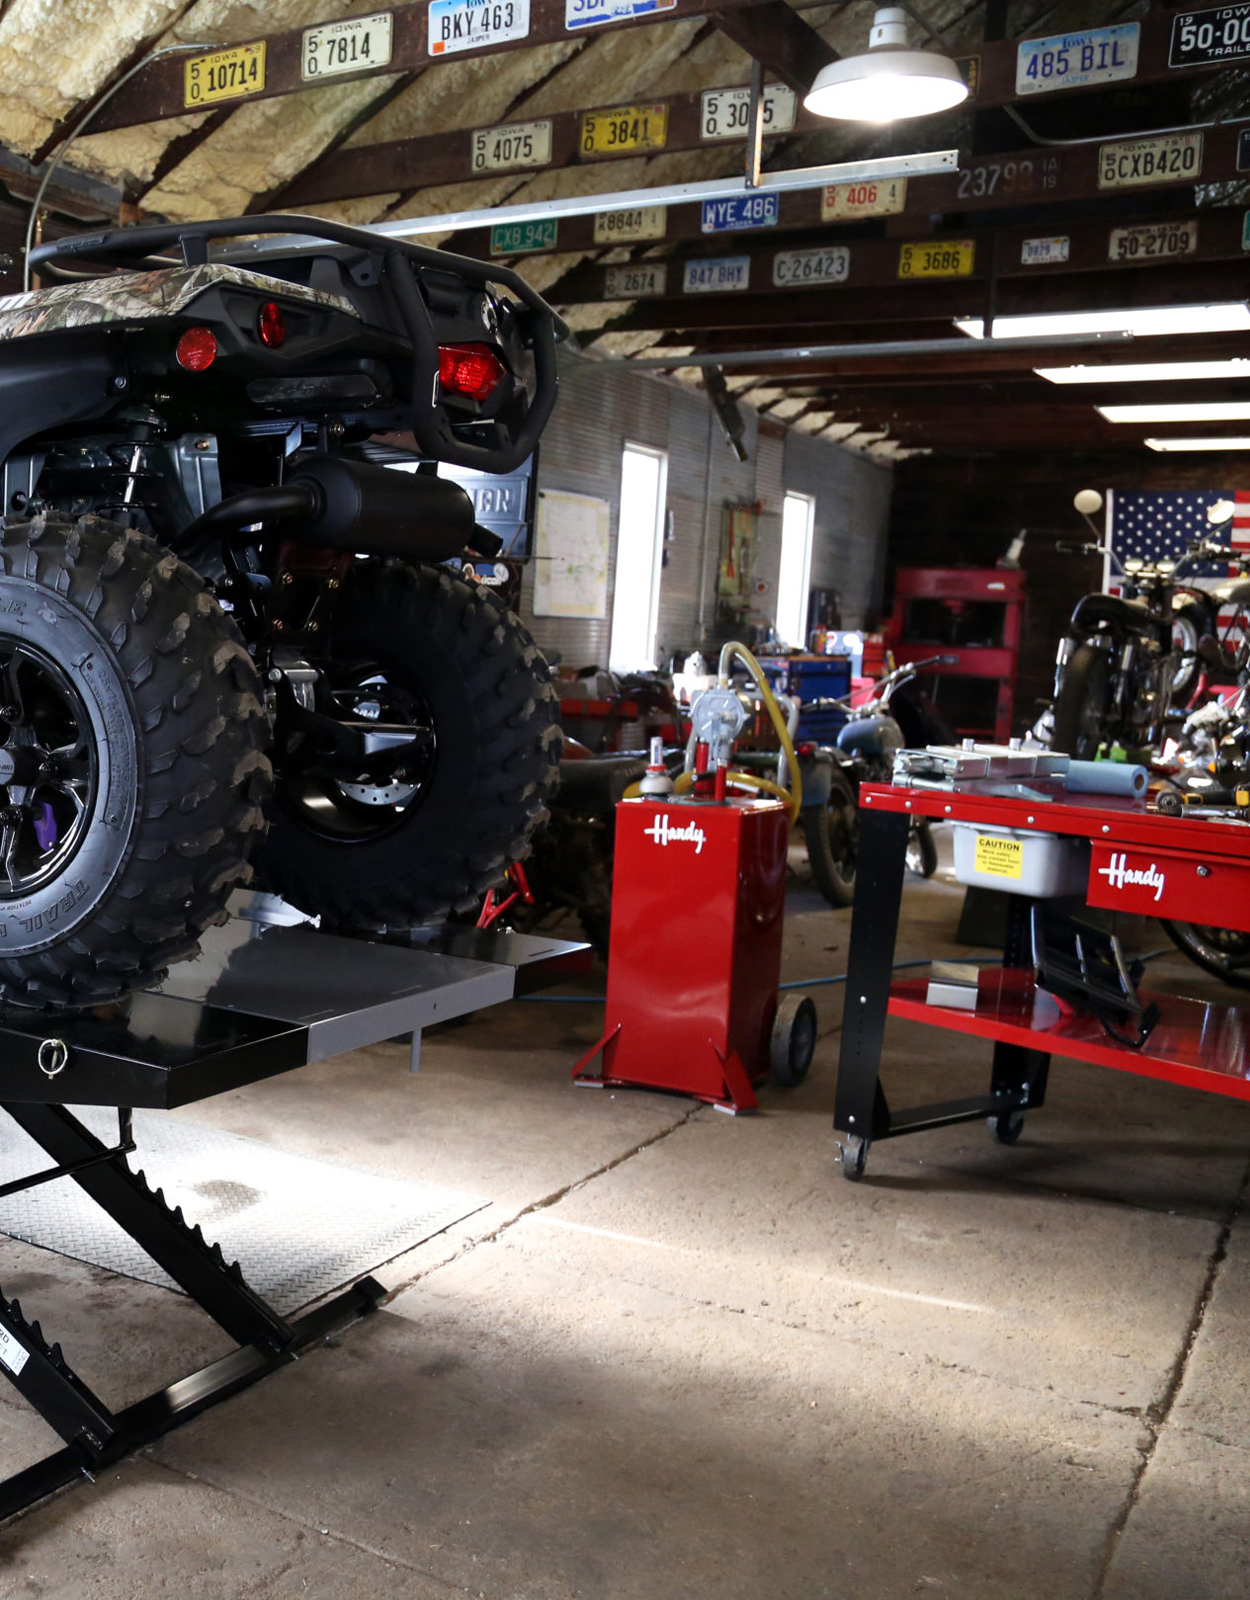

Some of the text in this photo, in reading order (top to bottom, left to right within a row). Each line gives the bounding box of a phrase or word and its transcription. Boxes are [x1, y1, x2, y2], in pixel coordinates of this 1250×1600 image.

[441, 3, 514, 40] BKY 463
[1216, 6, 1250, 19] IOW
[331, 22, 362, 33] IOWA
[1180, 17, 1250, 51] 50-00
[211, 52, 238, 63] IOWA
[327, 32, 370, 65] 7814
[1026, 40, 1125, 79] 485 BIL
[1207, 43, 1250, 56] TRAILE
[208, 57, 257, 92] 10714
[727, 99, 774, 129] 305
[607, 117, 649, 145] 3841
[493, 135, 532, 162] 4075
[1118, 146, 1195, 178] CXB420
[847, 185, 878, 205] 406
[706, 197, 775, 224] WYE 486
[526, 223, 553, 243] 942
[1118, 232, 1190, 257] 50-2709
[923, 250, 960, 271] 3686
[689, 266, 743, 285] 847 BHY
[644, 814, 707, 854] Handy
[979, 838, 1020, 851] CAUTION
[1098, 852, 1165, 901] Handy
[19, 878, 90, 933] TRAIL
